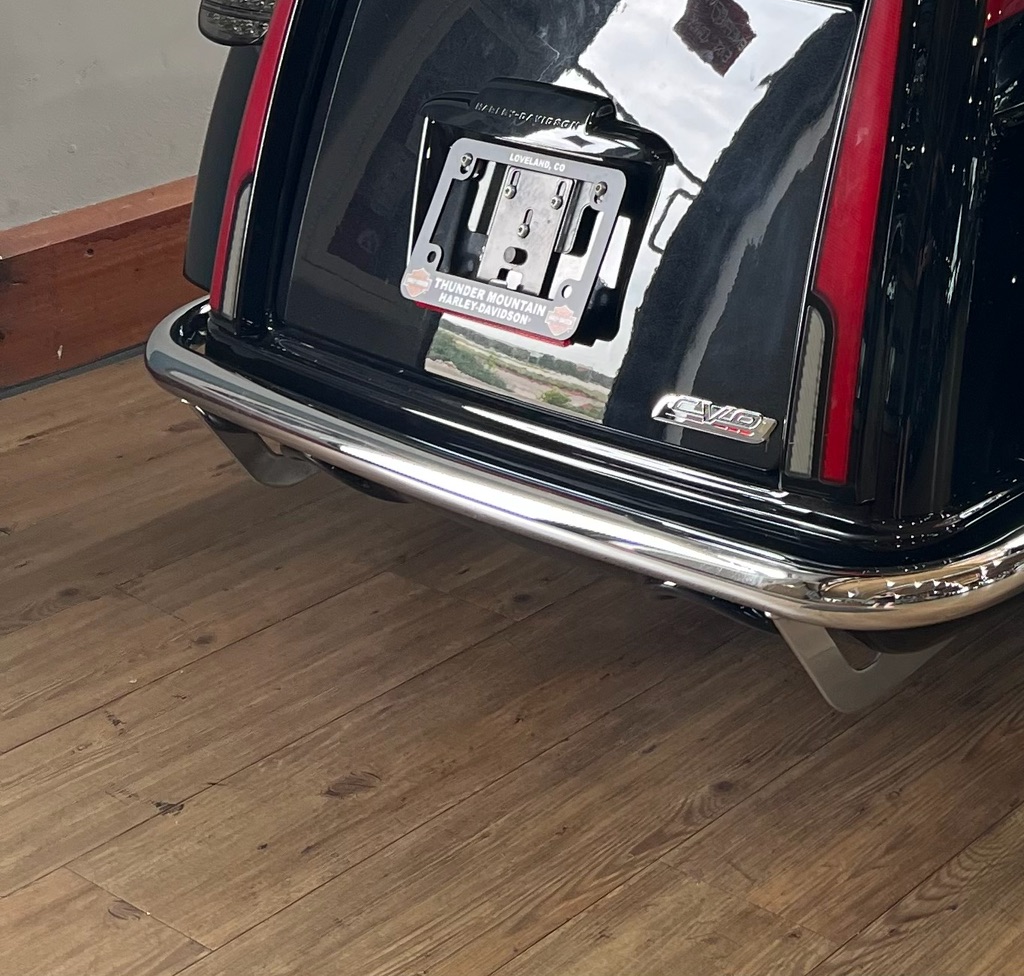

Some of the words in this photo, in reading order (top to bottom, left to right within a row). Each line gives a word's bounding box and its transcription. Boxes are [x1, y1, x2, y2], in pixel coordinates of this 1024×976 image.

[509, 153, 552, 170] LOVELAND,
[553, 162, 566, 172] CO
[434, 277, 485, 301] THUNDER
[486, 291, 548, 317] MOUNTAIN
[438, 293, 529, 325] HARLEY-DAVIDSON
